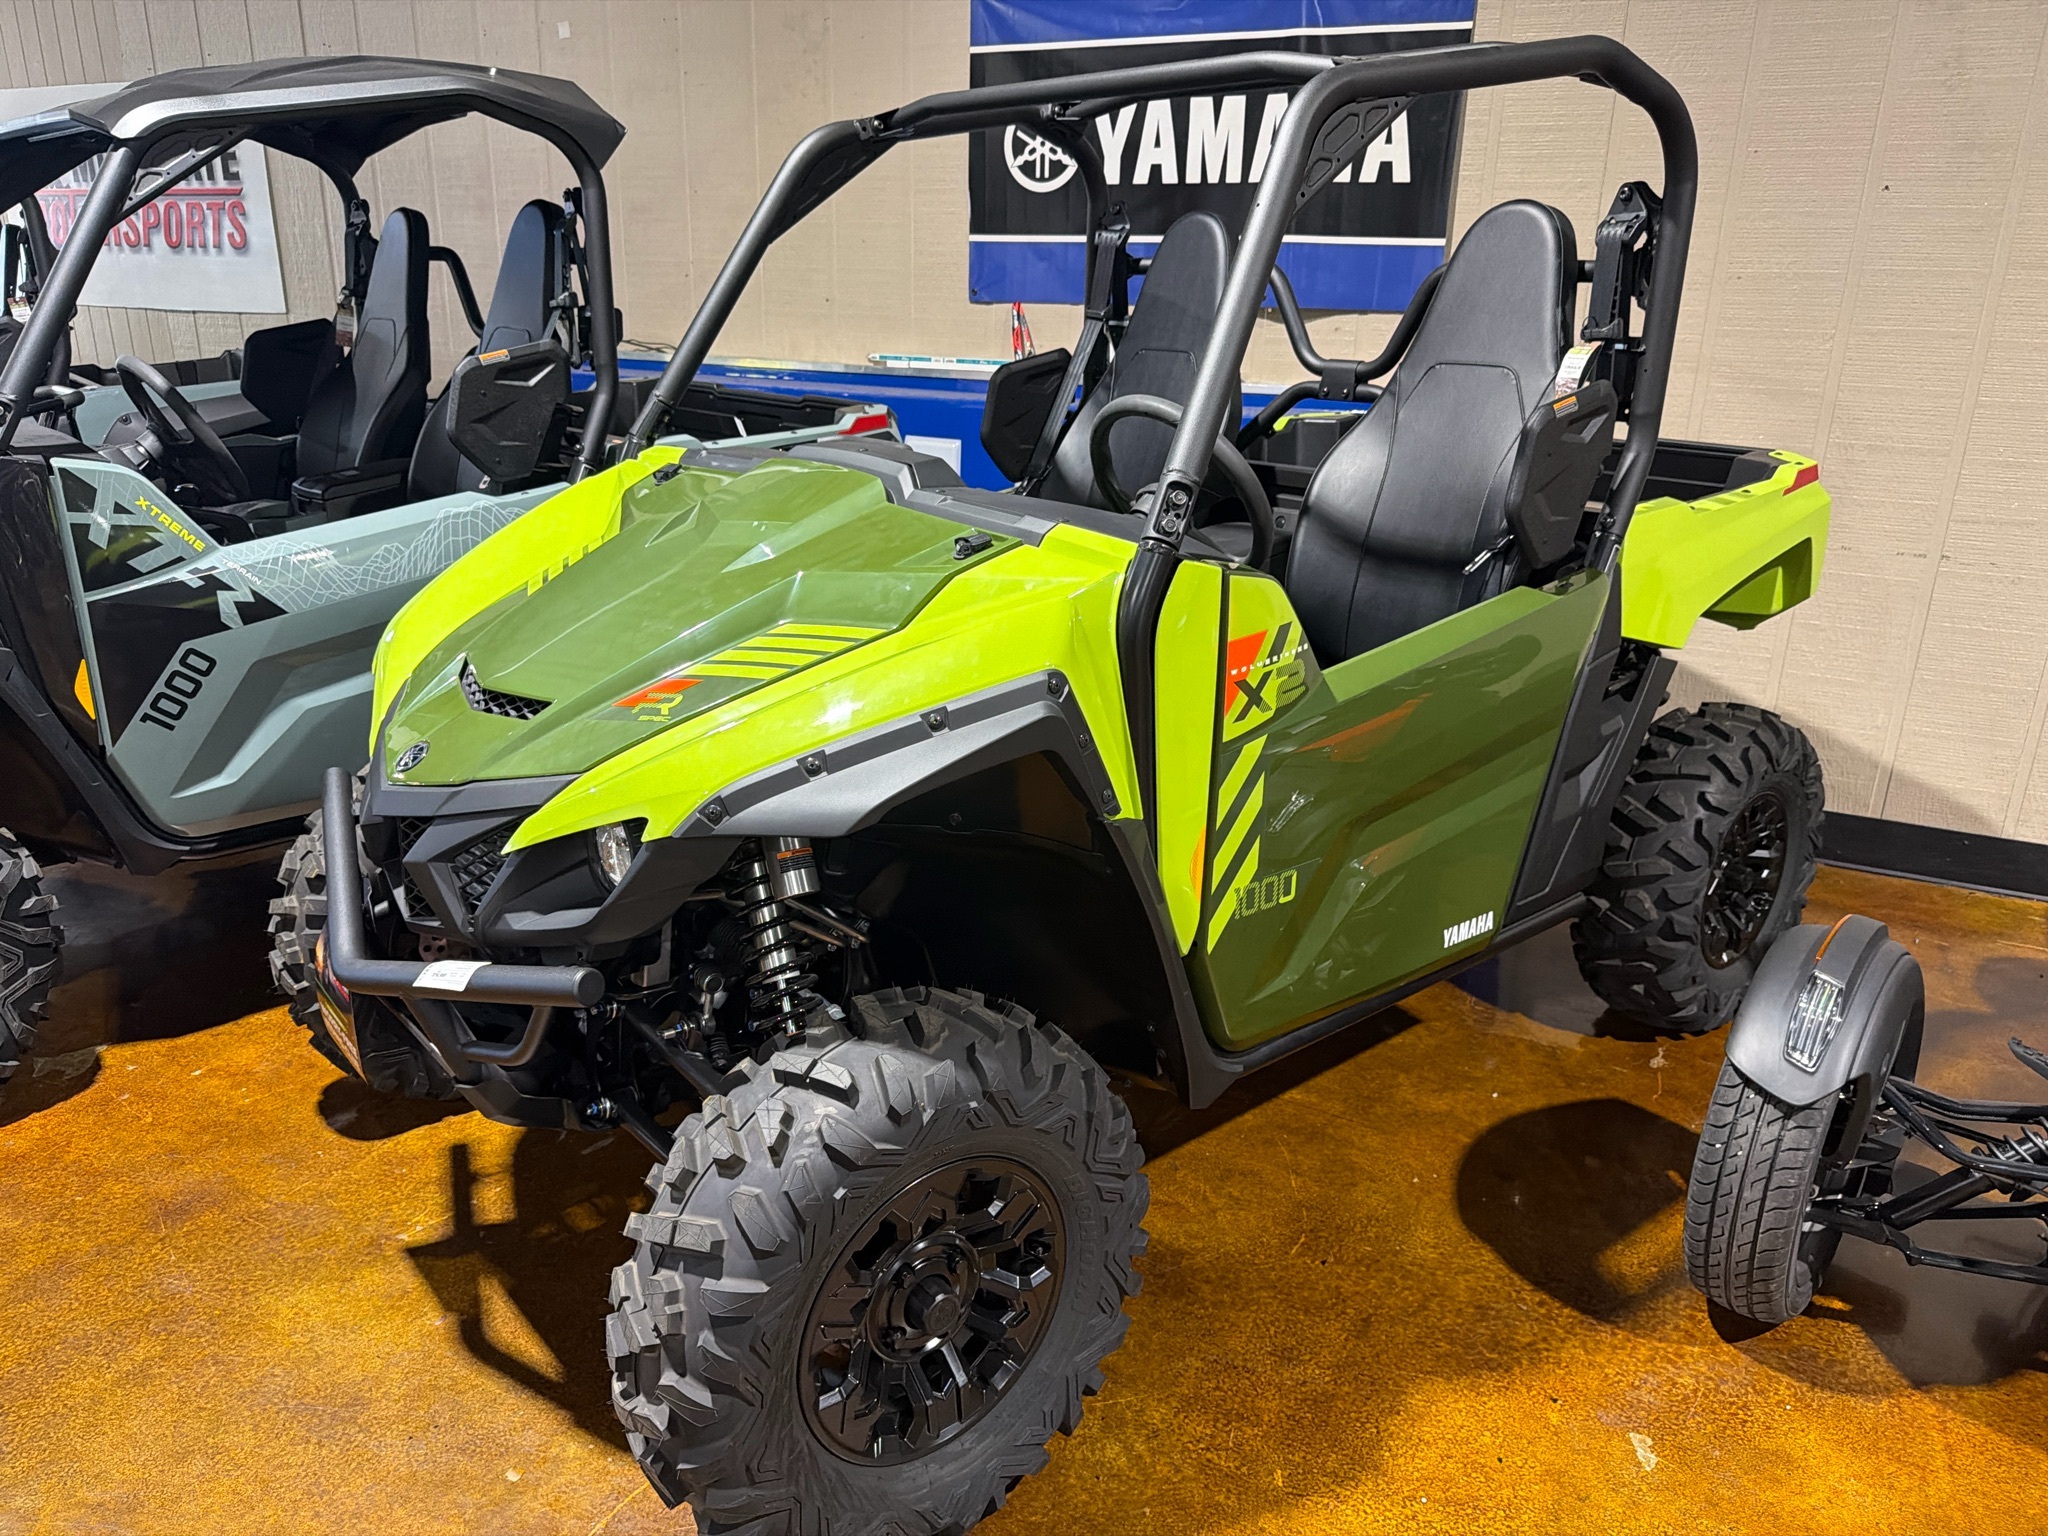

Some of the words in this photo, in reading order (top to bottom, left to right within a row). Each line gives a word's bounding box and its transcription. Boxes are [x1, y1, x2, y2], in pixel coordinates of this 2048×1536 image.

[1094, 93, 1411, 185] YAMAA
[135, 496, 206, 552] XTREME
[222, 559, 263, 585] TERRAIN
[139, 647, 218, 732] 1000
[1234, 869, 1298, 920] 1000
[1443, 910, 1494, 949] YAMAHA
